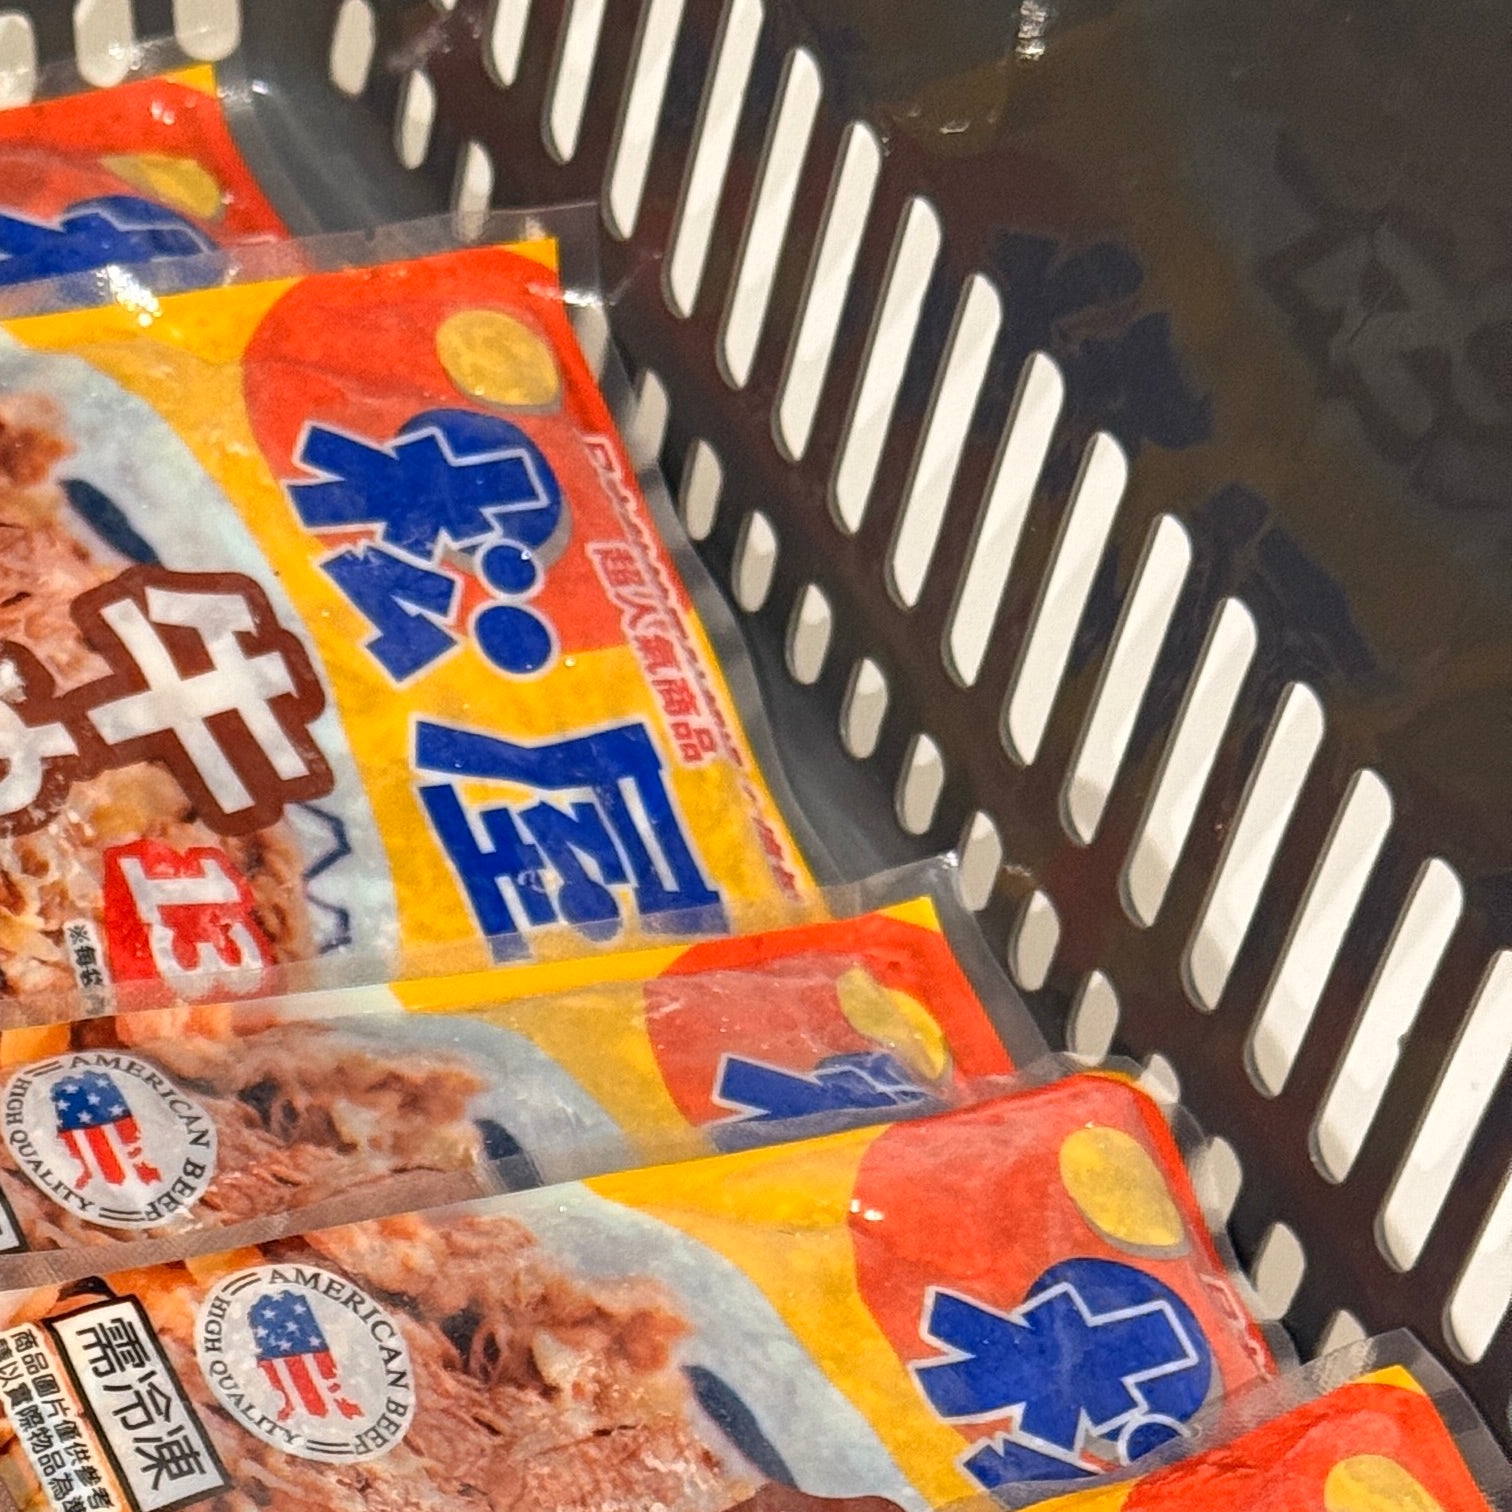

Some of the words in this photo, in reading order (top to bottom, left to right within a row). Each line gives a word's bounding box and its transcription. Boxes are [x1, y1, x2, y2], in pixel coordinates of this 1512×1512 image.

[7, 1078, 31, 1126] HIGH
[69, 1054, 210, 1147] AMERICAN
[143, 1152, 206, 1222] BEEF
[9, 1130, 94, 1211] QUALITY
[203, 1294, 231, 1356] HIGH
[267, 1268, 408, 1390] AMERICAN
[353, 1397, 407, 1455] BEEF
[76, 1318, 204, 1492] 需冷凍
[203, 1360, 298, 1449] QUALITY
